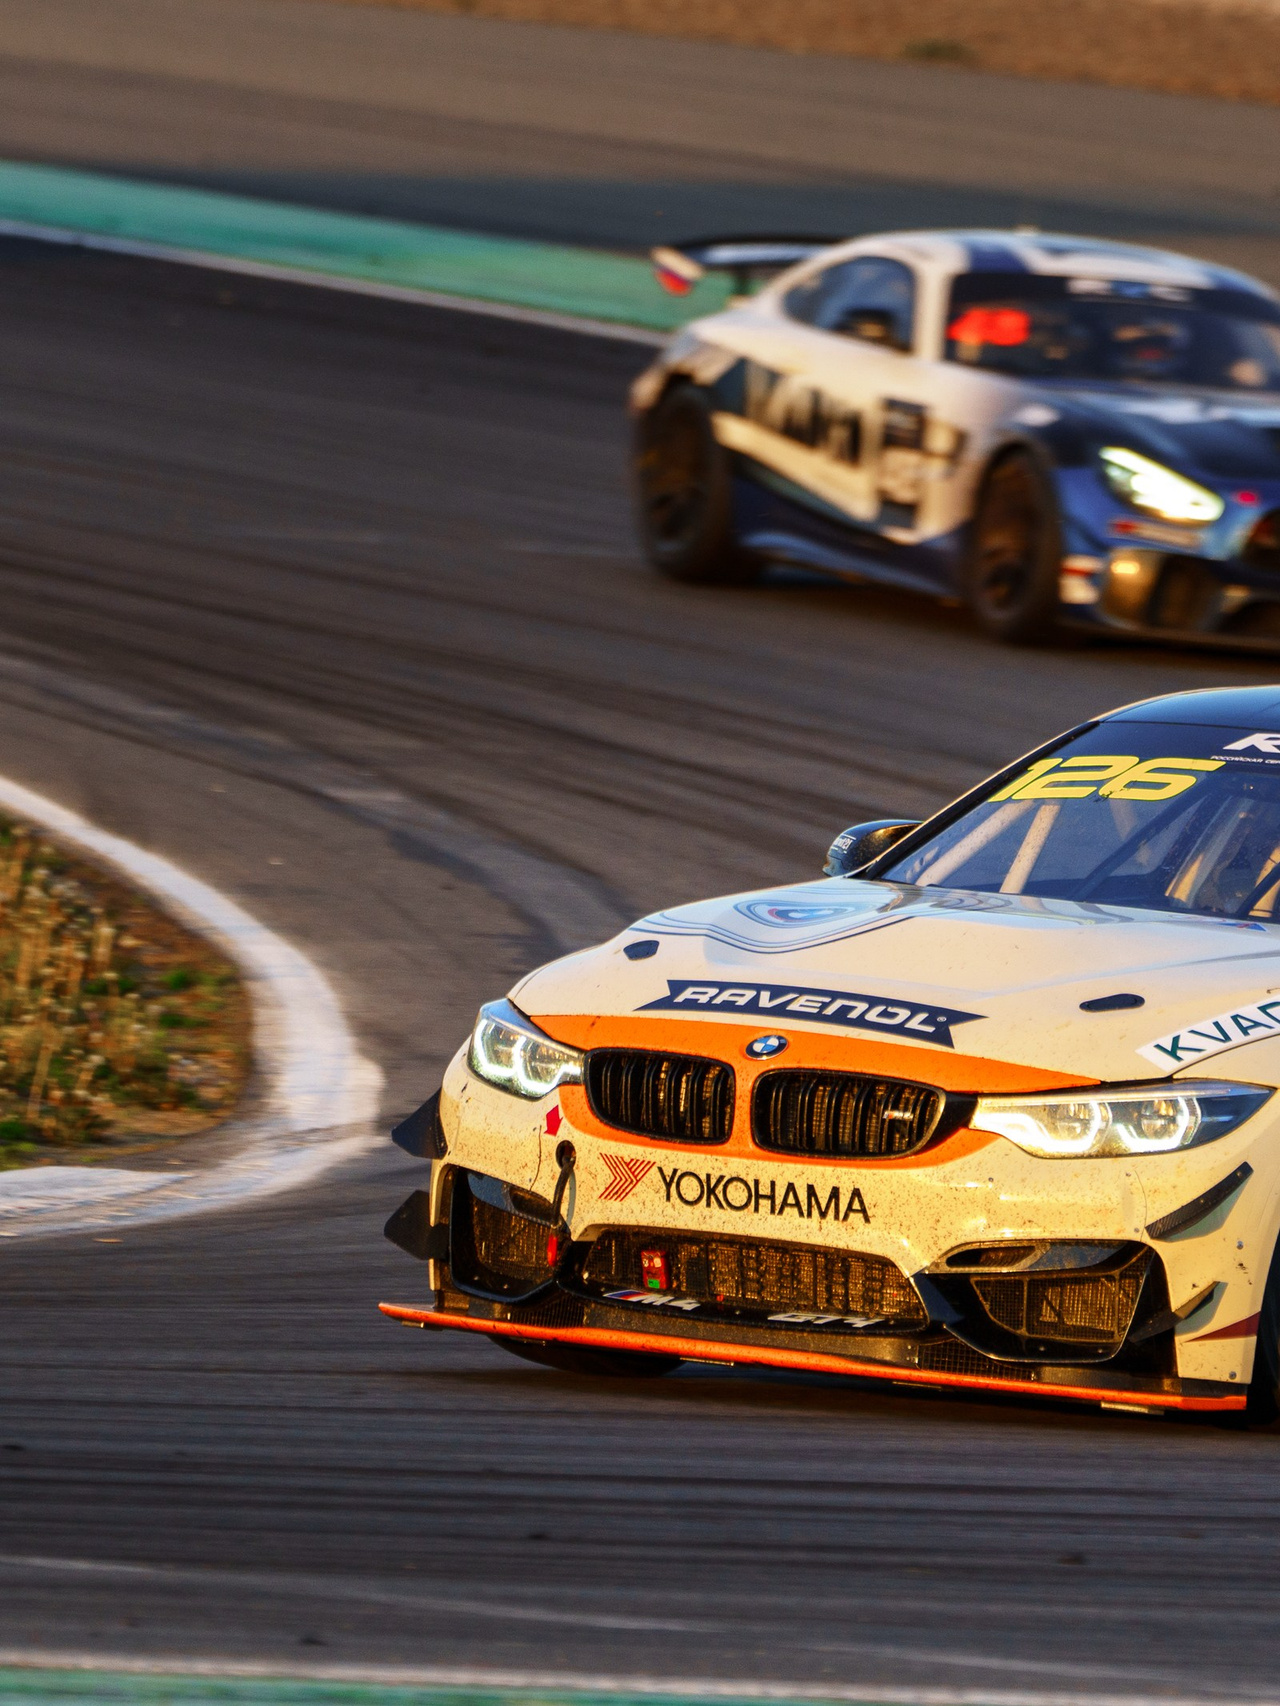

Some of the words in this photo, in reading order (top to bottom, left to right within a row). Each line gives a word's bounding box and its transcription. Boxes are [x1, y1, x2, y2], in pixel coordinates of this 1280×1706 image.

[989, 755, 1226, 802] 126
[672, 985, 940, 1034] RAVENOL
[658, 1165, 872, 1224] YOKOHAMA
